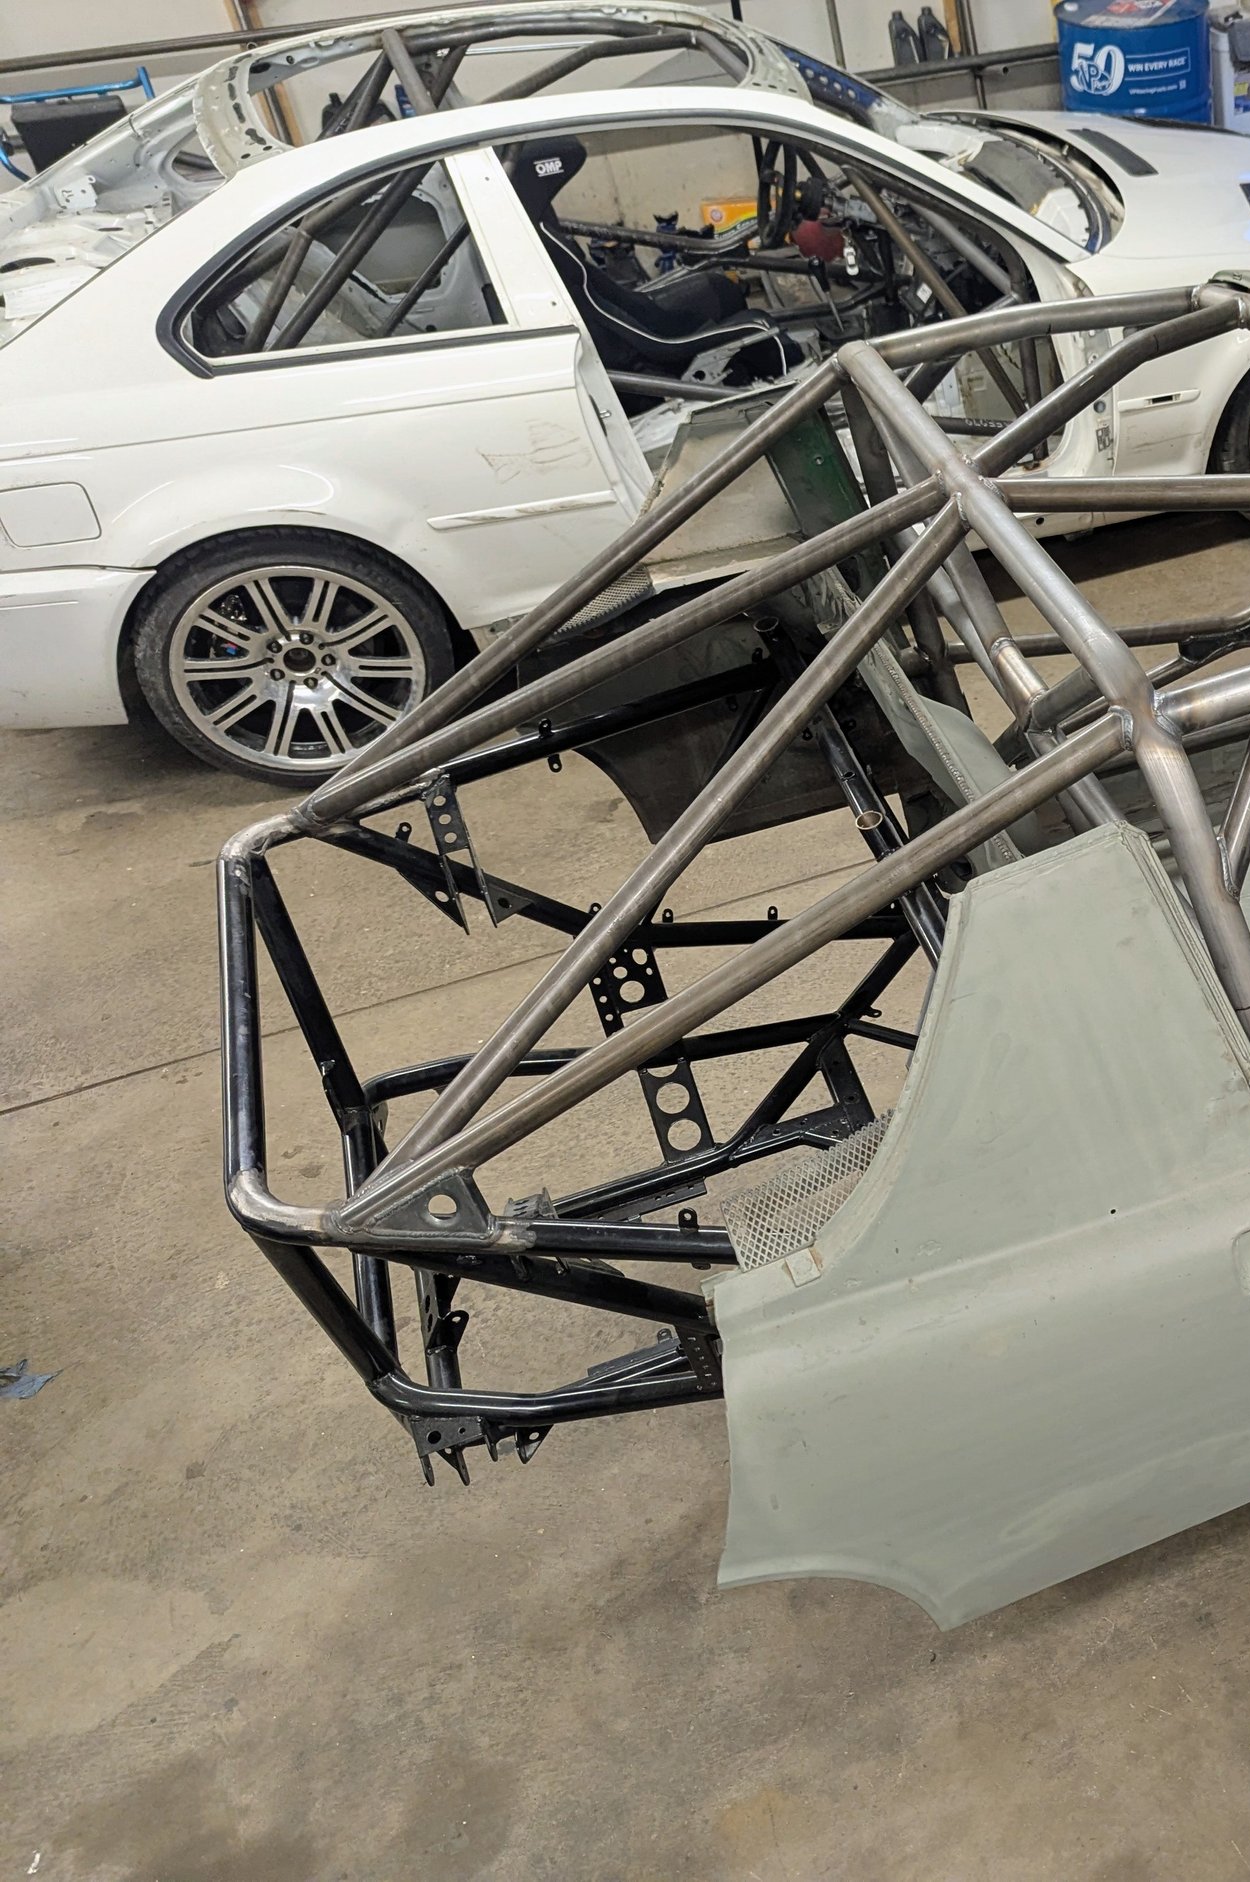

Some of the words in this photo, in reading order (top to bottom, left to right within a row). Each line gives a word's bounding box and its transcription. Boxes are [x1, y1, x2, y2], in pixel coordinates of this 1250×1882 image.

[1070, 42, 1125, 96] 50
[1128, 63, 1144, 73] WIN
[1144, 60, 1168, 72] EVERY
[1168, 56, 1186, 69] RACE
[535, 160, 562, 174] OMP
